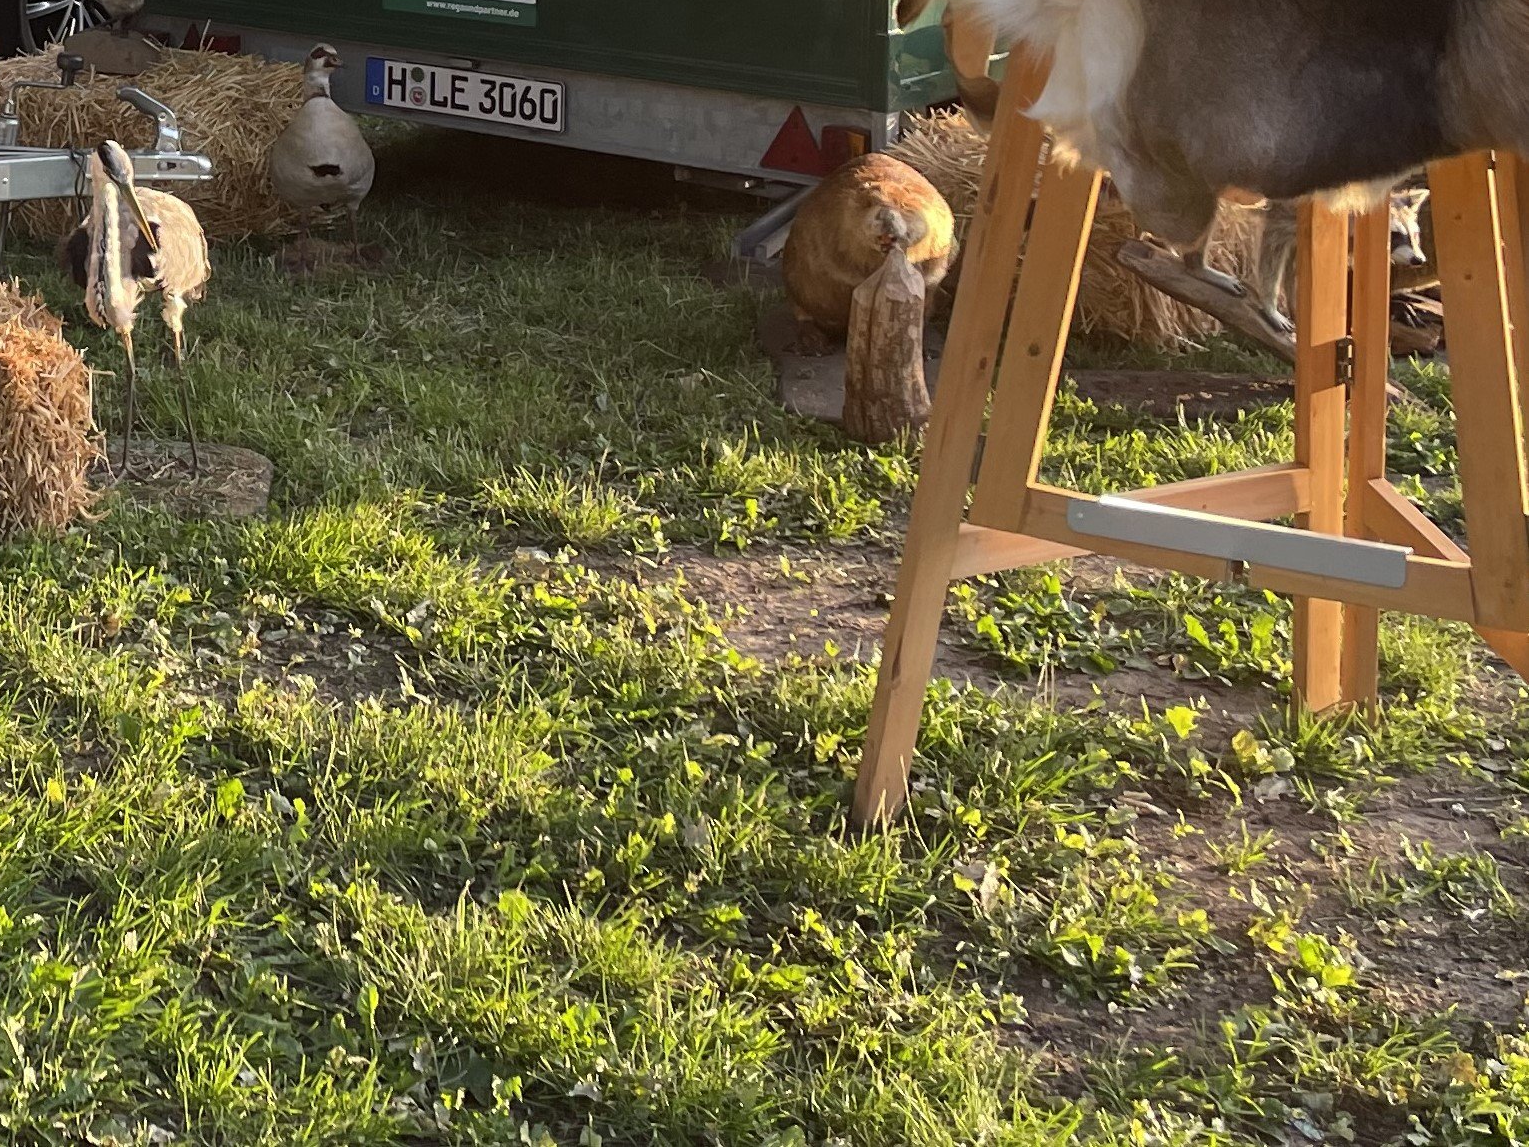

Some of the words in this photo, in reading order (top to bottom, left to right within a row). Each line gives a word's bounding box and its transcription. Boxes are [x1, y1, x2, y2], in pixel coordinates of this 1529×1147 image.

[426, 1, 519, 17] www.regaundpartner.de
[373, 86, 379, 95] D
[387, 66, 407, 101] H
[430, 71, 469, 111] LE
[479, 79, 558, 124] 3060
